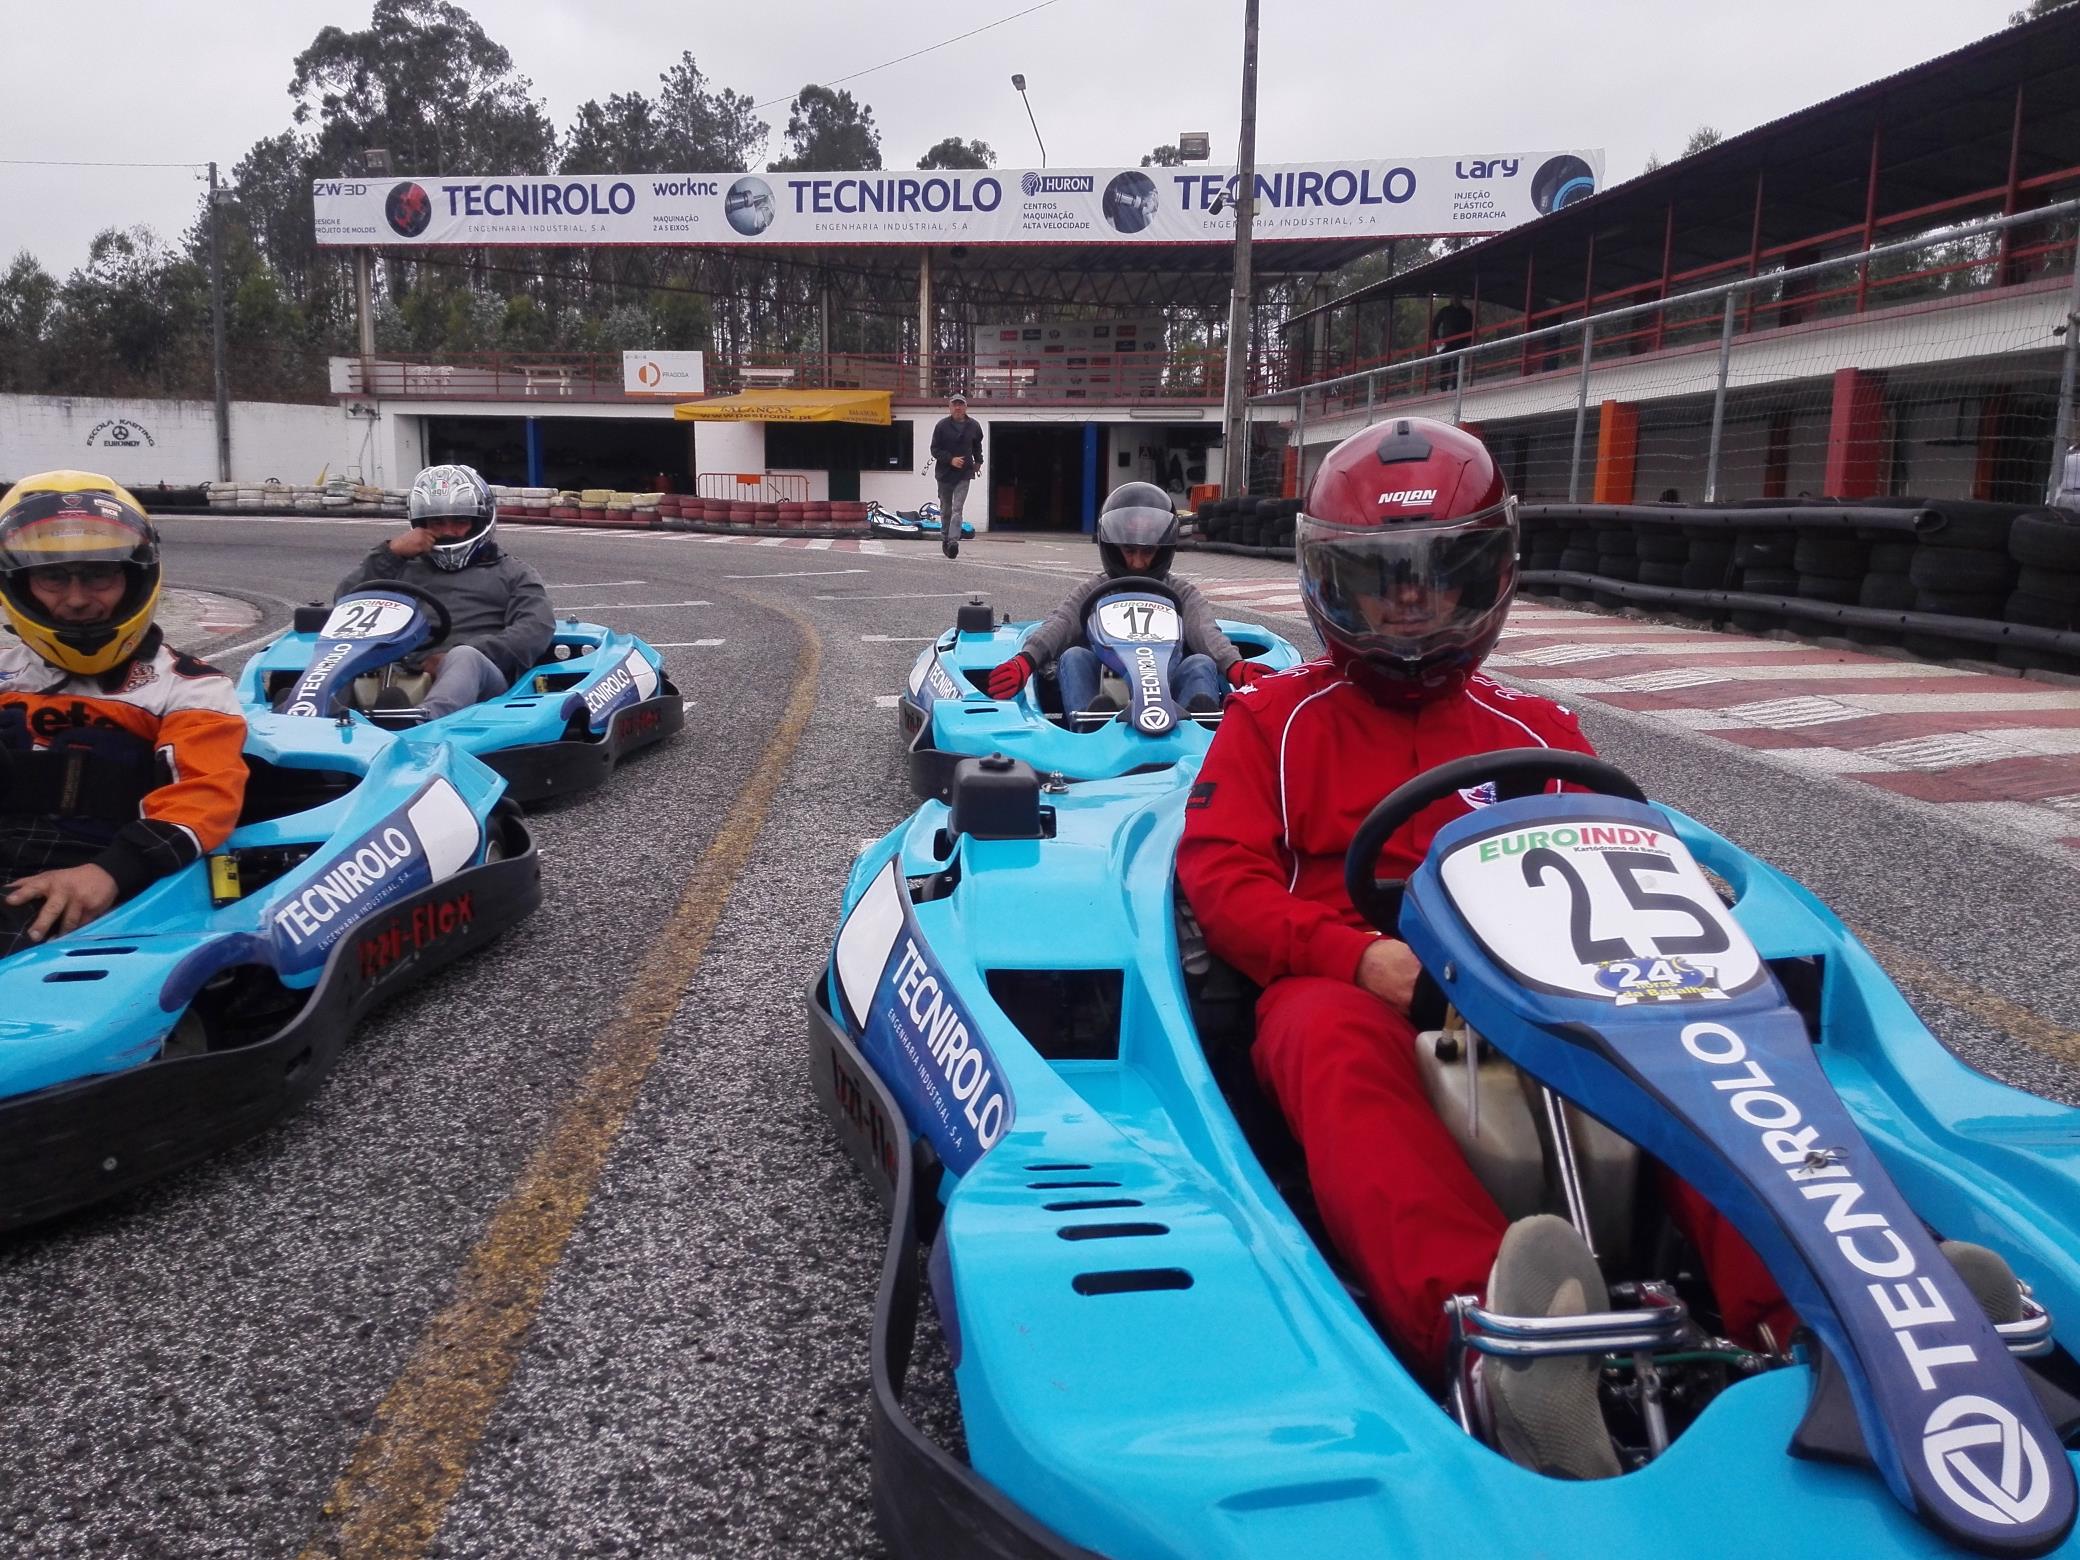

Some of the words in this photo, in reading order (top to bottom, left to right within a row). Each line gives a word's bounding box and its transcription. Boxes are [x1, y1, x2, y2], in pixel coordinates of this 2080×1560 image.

[313, 183, 367, 196] ZW3D
[653, 177, 718, 196] worknc
[788, 177, 1002, 213] TECNIROLO
[1046, 178, 1090, 190] HURON
[1454, 190, 1490, 200] INJEÇÃO
[442, 182, 635, 216] TECNIROLO
[1453, 200, 1494, 210] PLÁSTICO
[468, 224, 526, 232] ENGENHARIA
[653, 214, 699, 223] MAQUINAÇÃO
[815, 223, 879, 231] ENGENHARIA
[1022, 211, 1074, 220] MAQUINAÇÃO
[1460, 211, 1506, 220] BORRACHA
[86, 419, 115, 447] ESCOLA
[119, 419, 155, 447] KARTING
[1378, 489, 1437, 507] NOLAN
[334, 605, 383, 633] 24
[1123, 607, 1154, 634] 17
[296, 643, 353, 701] TECNIROLO
[1136, 647, 1162, 706] TECNIROLO
[584, 668, 631, 714] ECNIROLO
[1478, 827, 1660, 863] EUROINDY
[274, 827, 412, 945] TECNIROLO
[1521, 848, 1730, 965] 25
[318, 912, 360, 951] ENGENHARIA
[887, 1008, 918, 1066] ENGENHARIA
[892, 937, 1003, 1150] TECNIROLO
[1680, 1021, 1977, 1391] TECNIROLO
